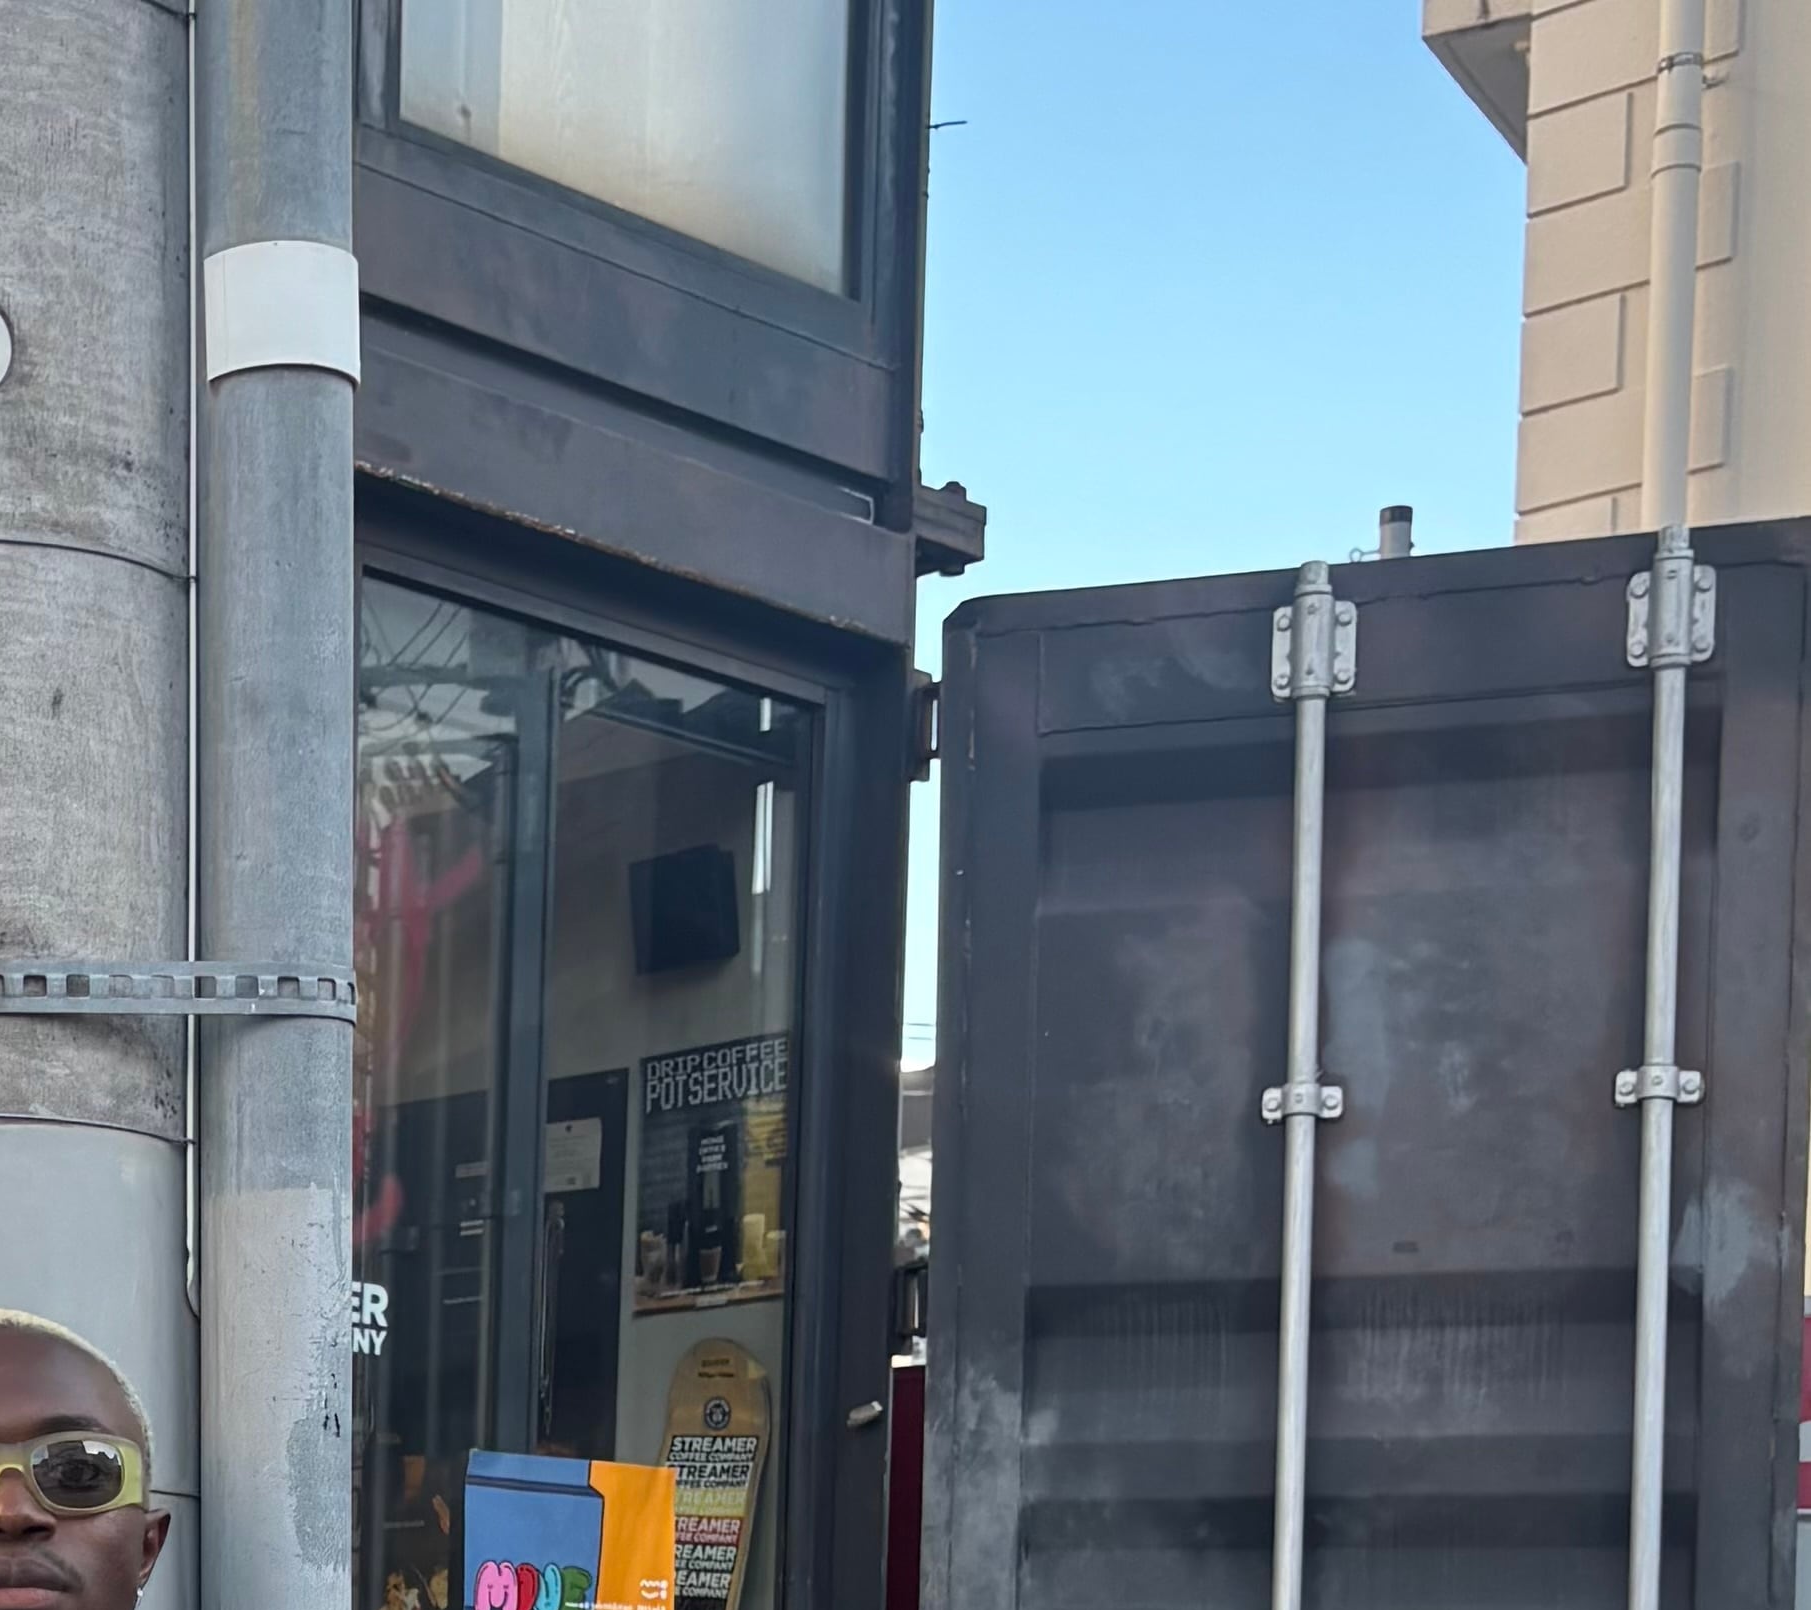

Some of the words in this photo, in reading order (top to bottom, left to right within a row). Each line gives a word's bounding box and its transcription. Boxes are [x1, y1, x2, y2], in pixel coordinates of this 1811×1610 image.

[646, 1054, 701, 1081] DRIP
[702, 1038, 787, 1070] COFFEE
[646, 1075, 684, 1114] POT
[688, 1058, 787, 1105] SERVICE
[352, 1327, 388, 1356] NY
[669, 1451, 706, 1462] COFFEE
[708, 1452, 754, 1463] COMPANY
[672, 1437, 757, 1452] STREAMER
